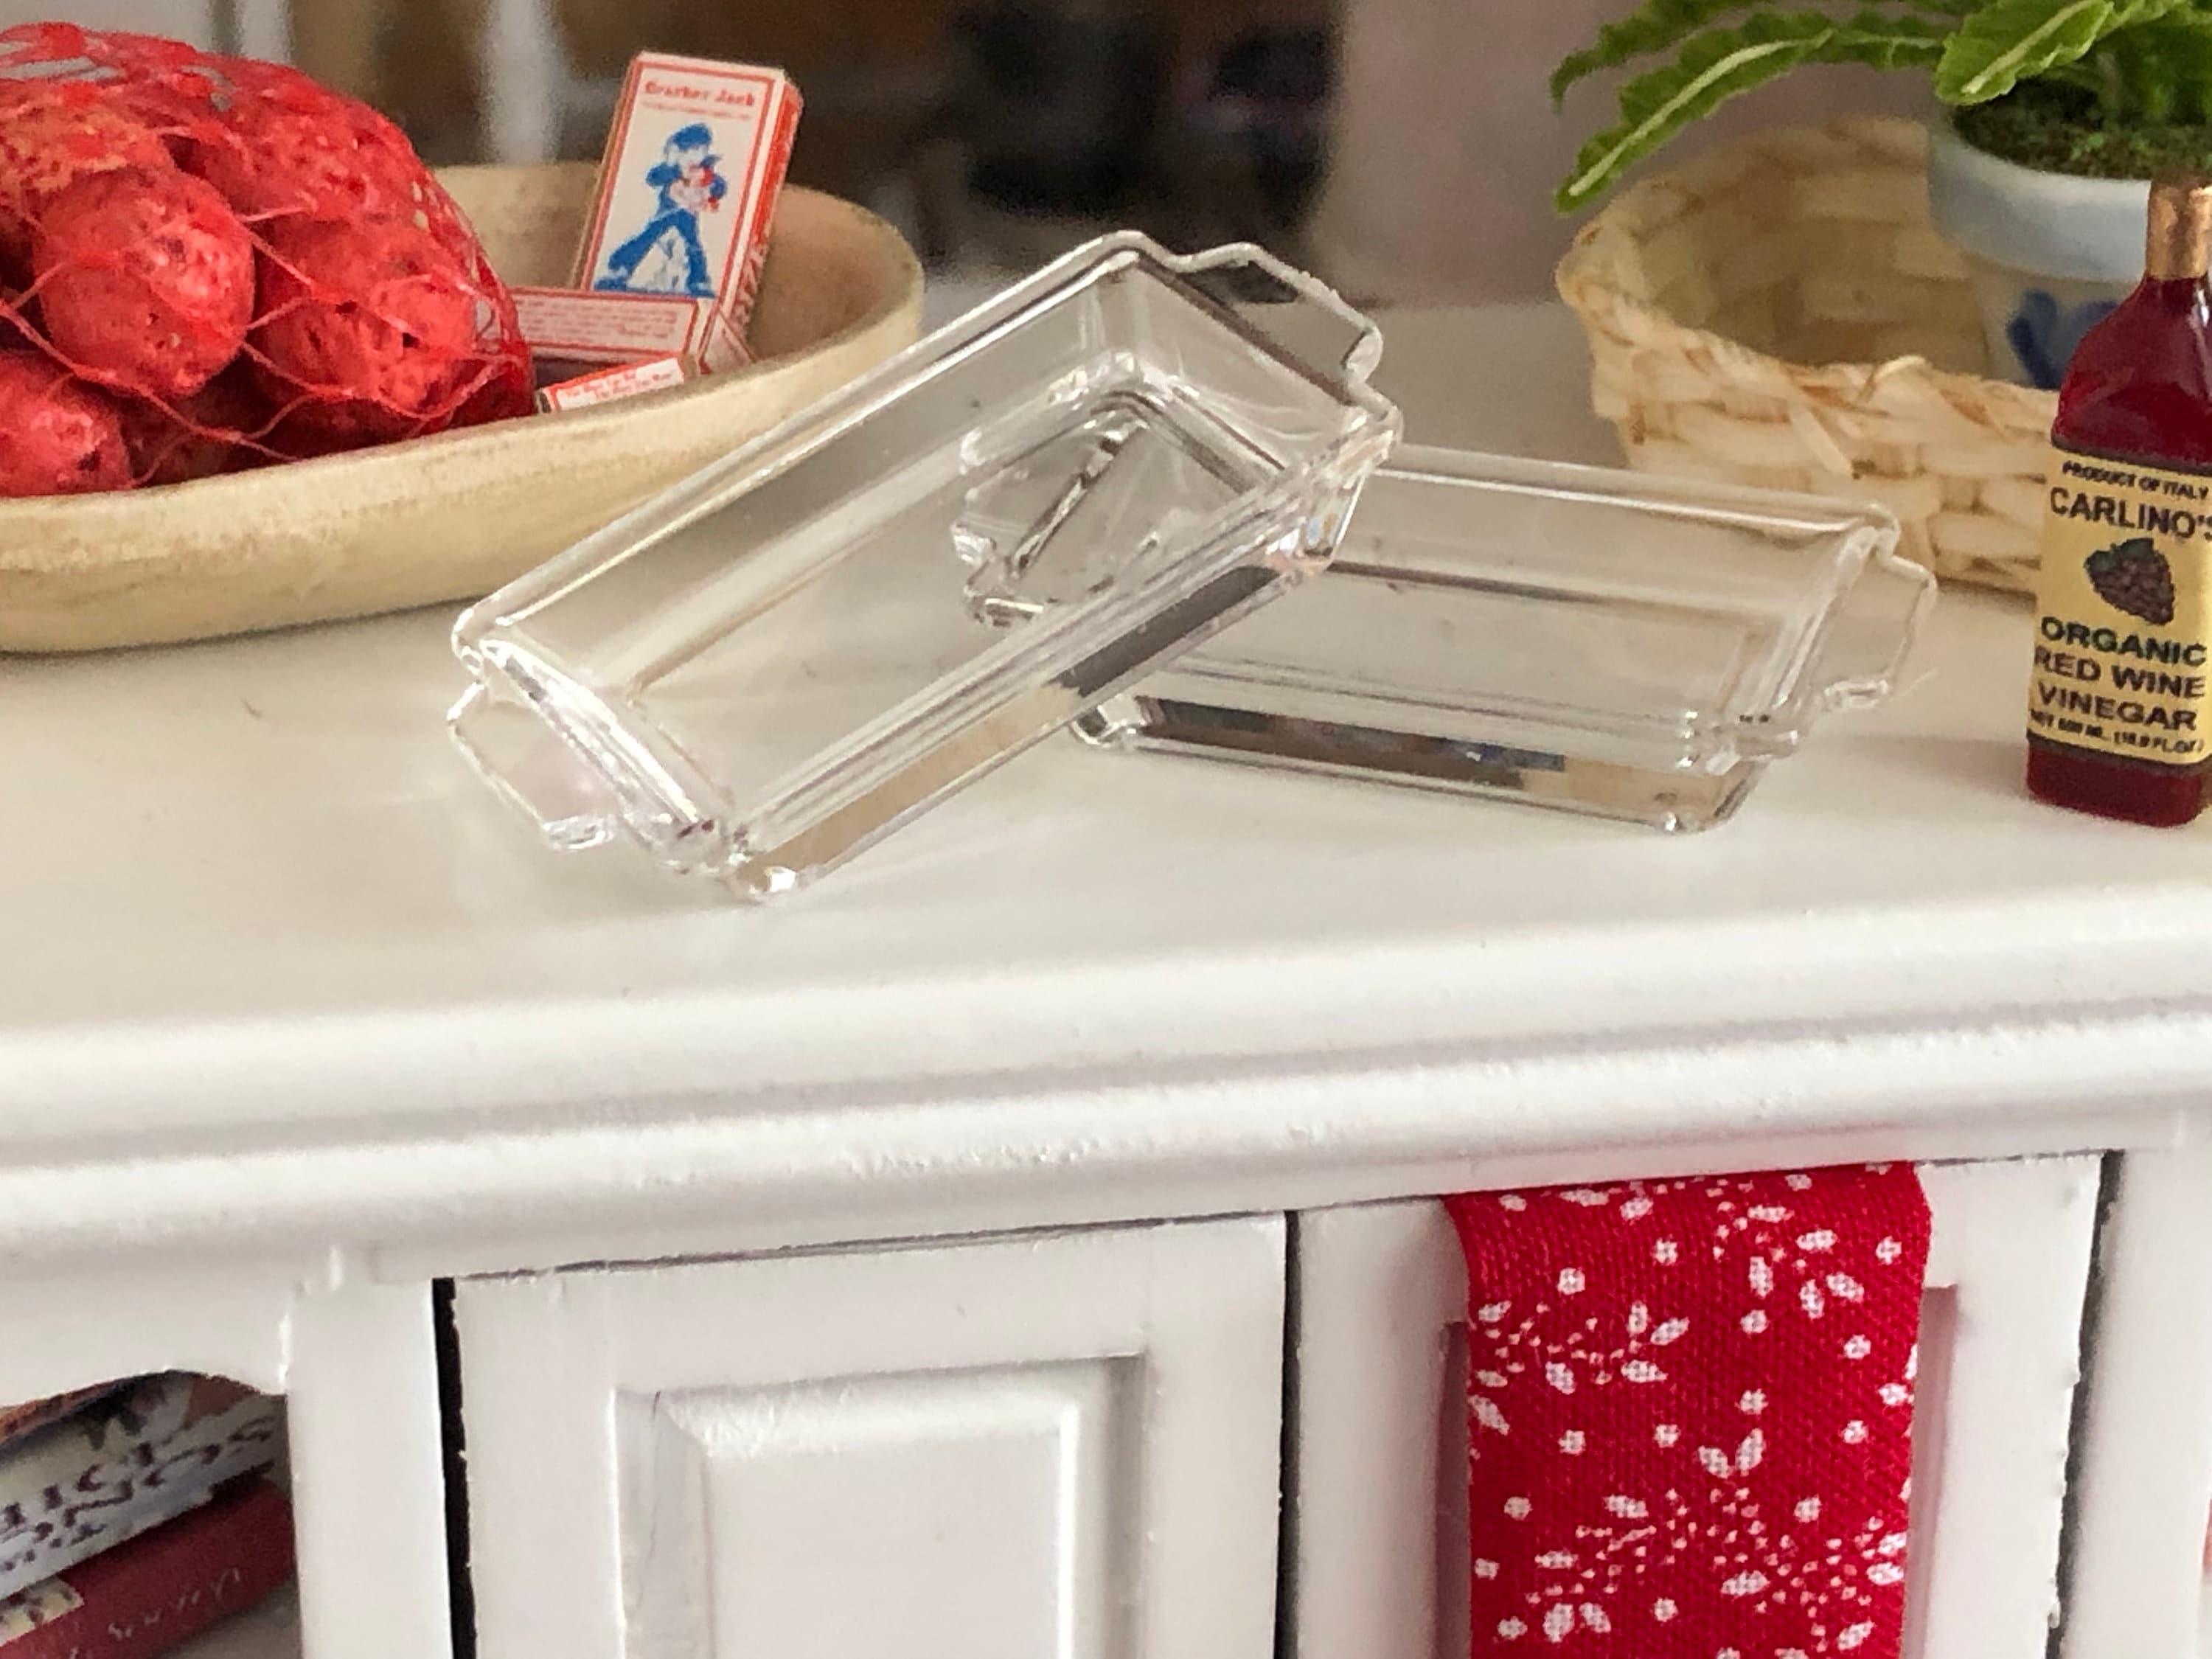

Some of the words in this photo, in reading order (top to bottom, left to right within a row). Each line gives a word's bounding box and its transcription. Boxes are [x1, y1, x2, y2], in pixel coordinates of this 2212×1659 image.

[714, 88, 754, 106] Jack
[2138, 476, 2160, 491] OF
[2163, 481, 2209, 500] ITALY
[2041, 616, 2207, 667] ORGANIC
[2034, 644, 2101, 681] RED
[2111, 664, 2206, 699] WINE
[2038, 681, 2197, 730] VINEGAR
